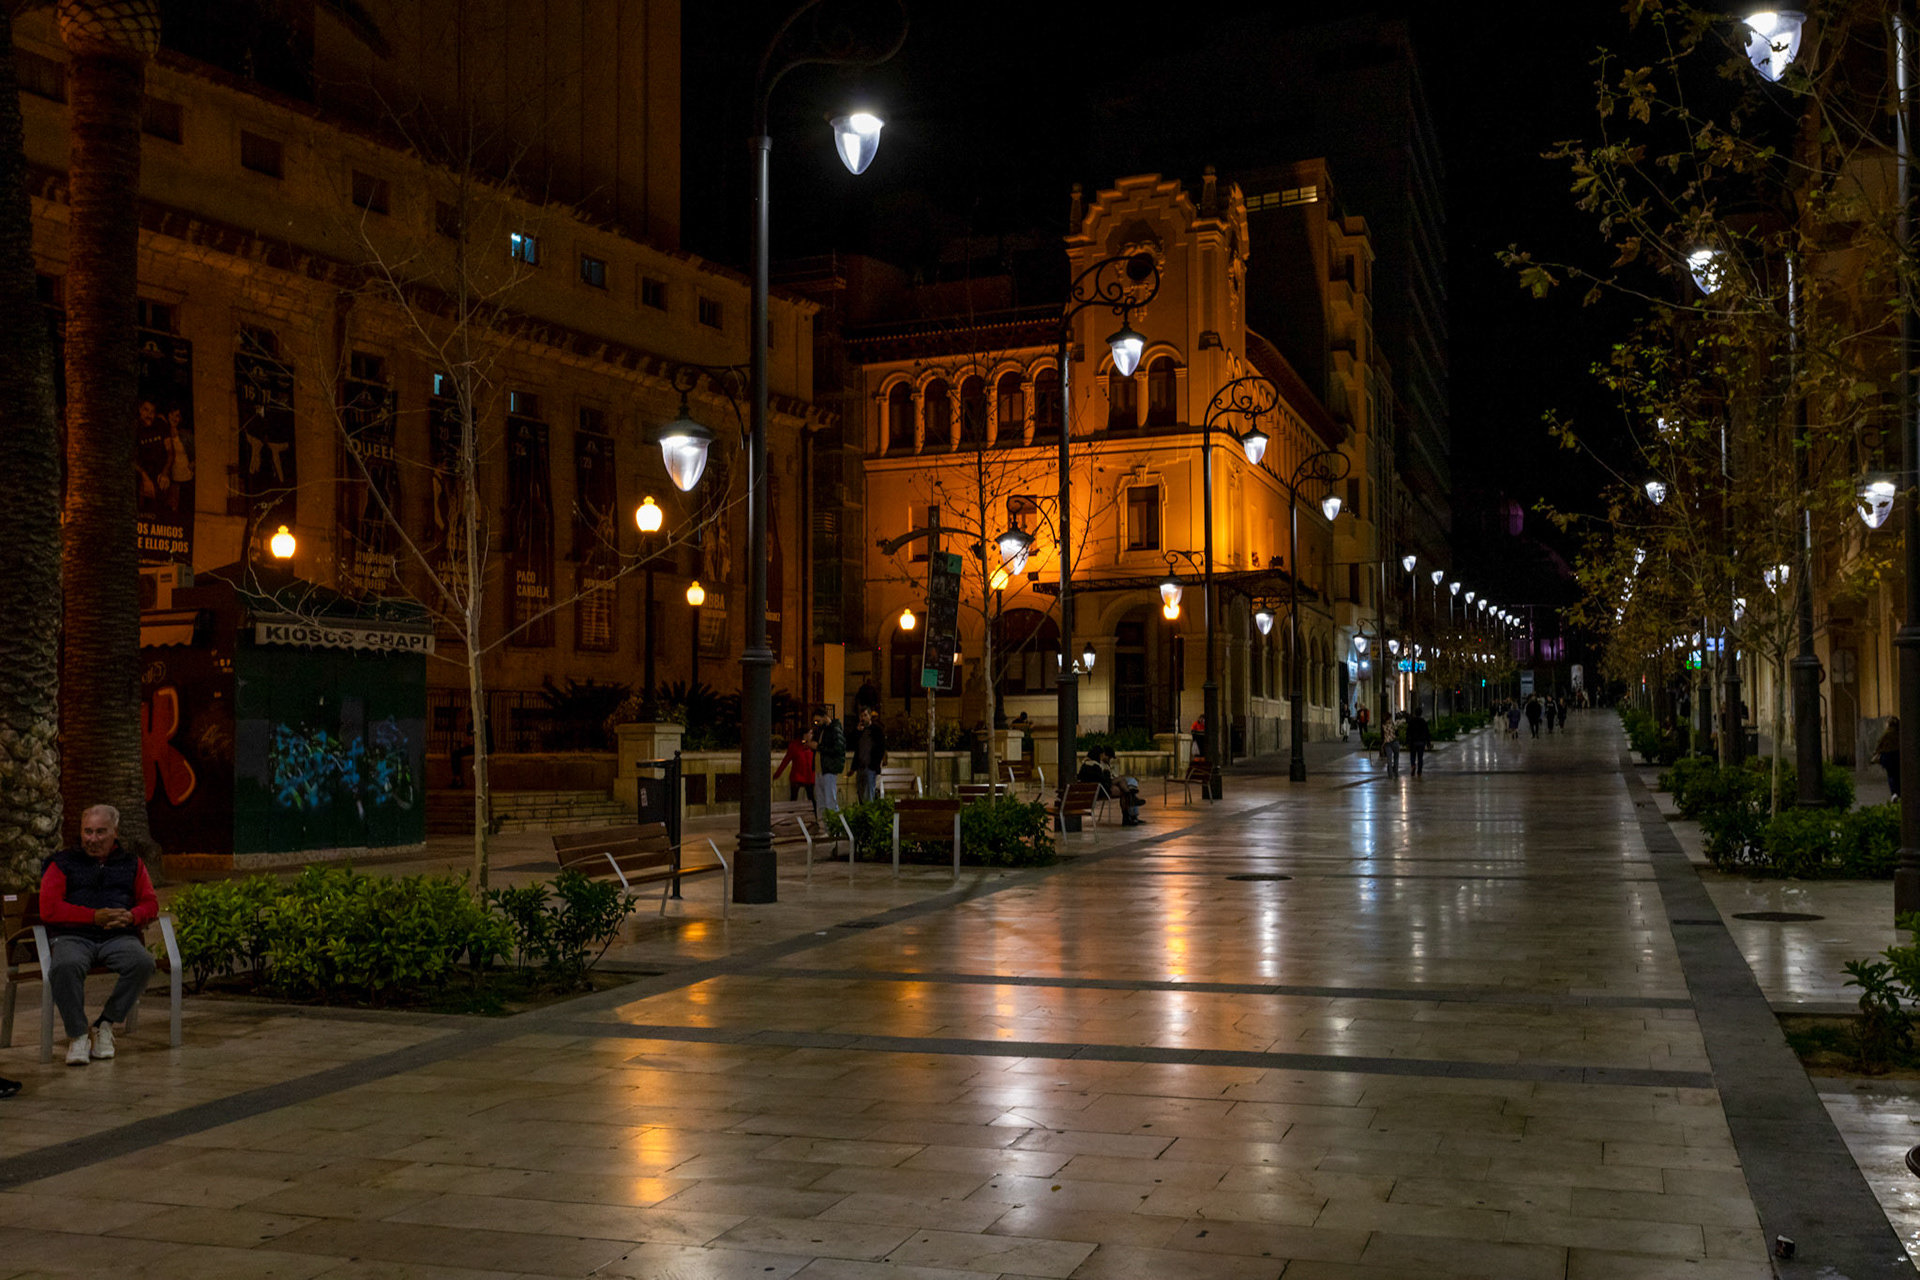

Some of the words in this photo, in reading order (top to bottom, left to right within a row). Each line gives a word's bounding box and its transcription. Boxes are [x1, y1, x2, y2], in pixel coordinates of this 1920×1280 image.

[137, 522, 149, 536] OS
[150, 523, 184, 539] AMIGOS
[137, 536, 144, 549] E
[145, 537, 170, 552] ELLOS
[171, 540, 189, 554] DOS
[516, 569, 536, 584] PACO
[516, 584, 549, 599] CANDELA
[265, 626, 354, 645] KIOSCO
